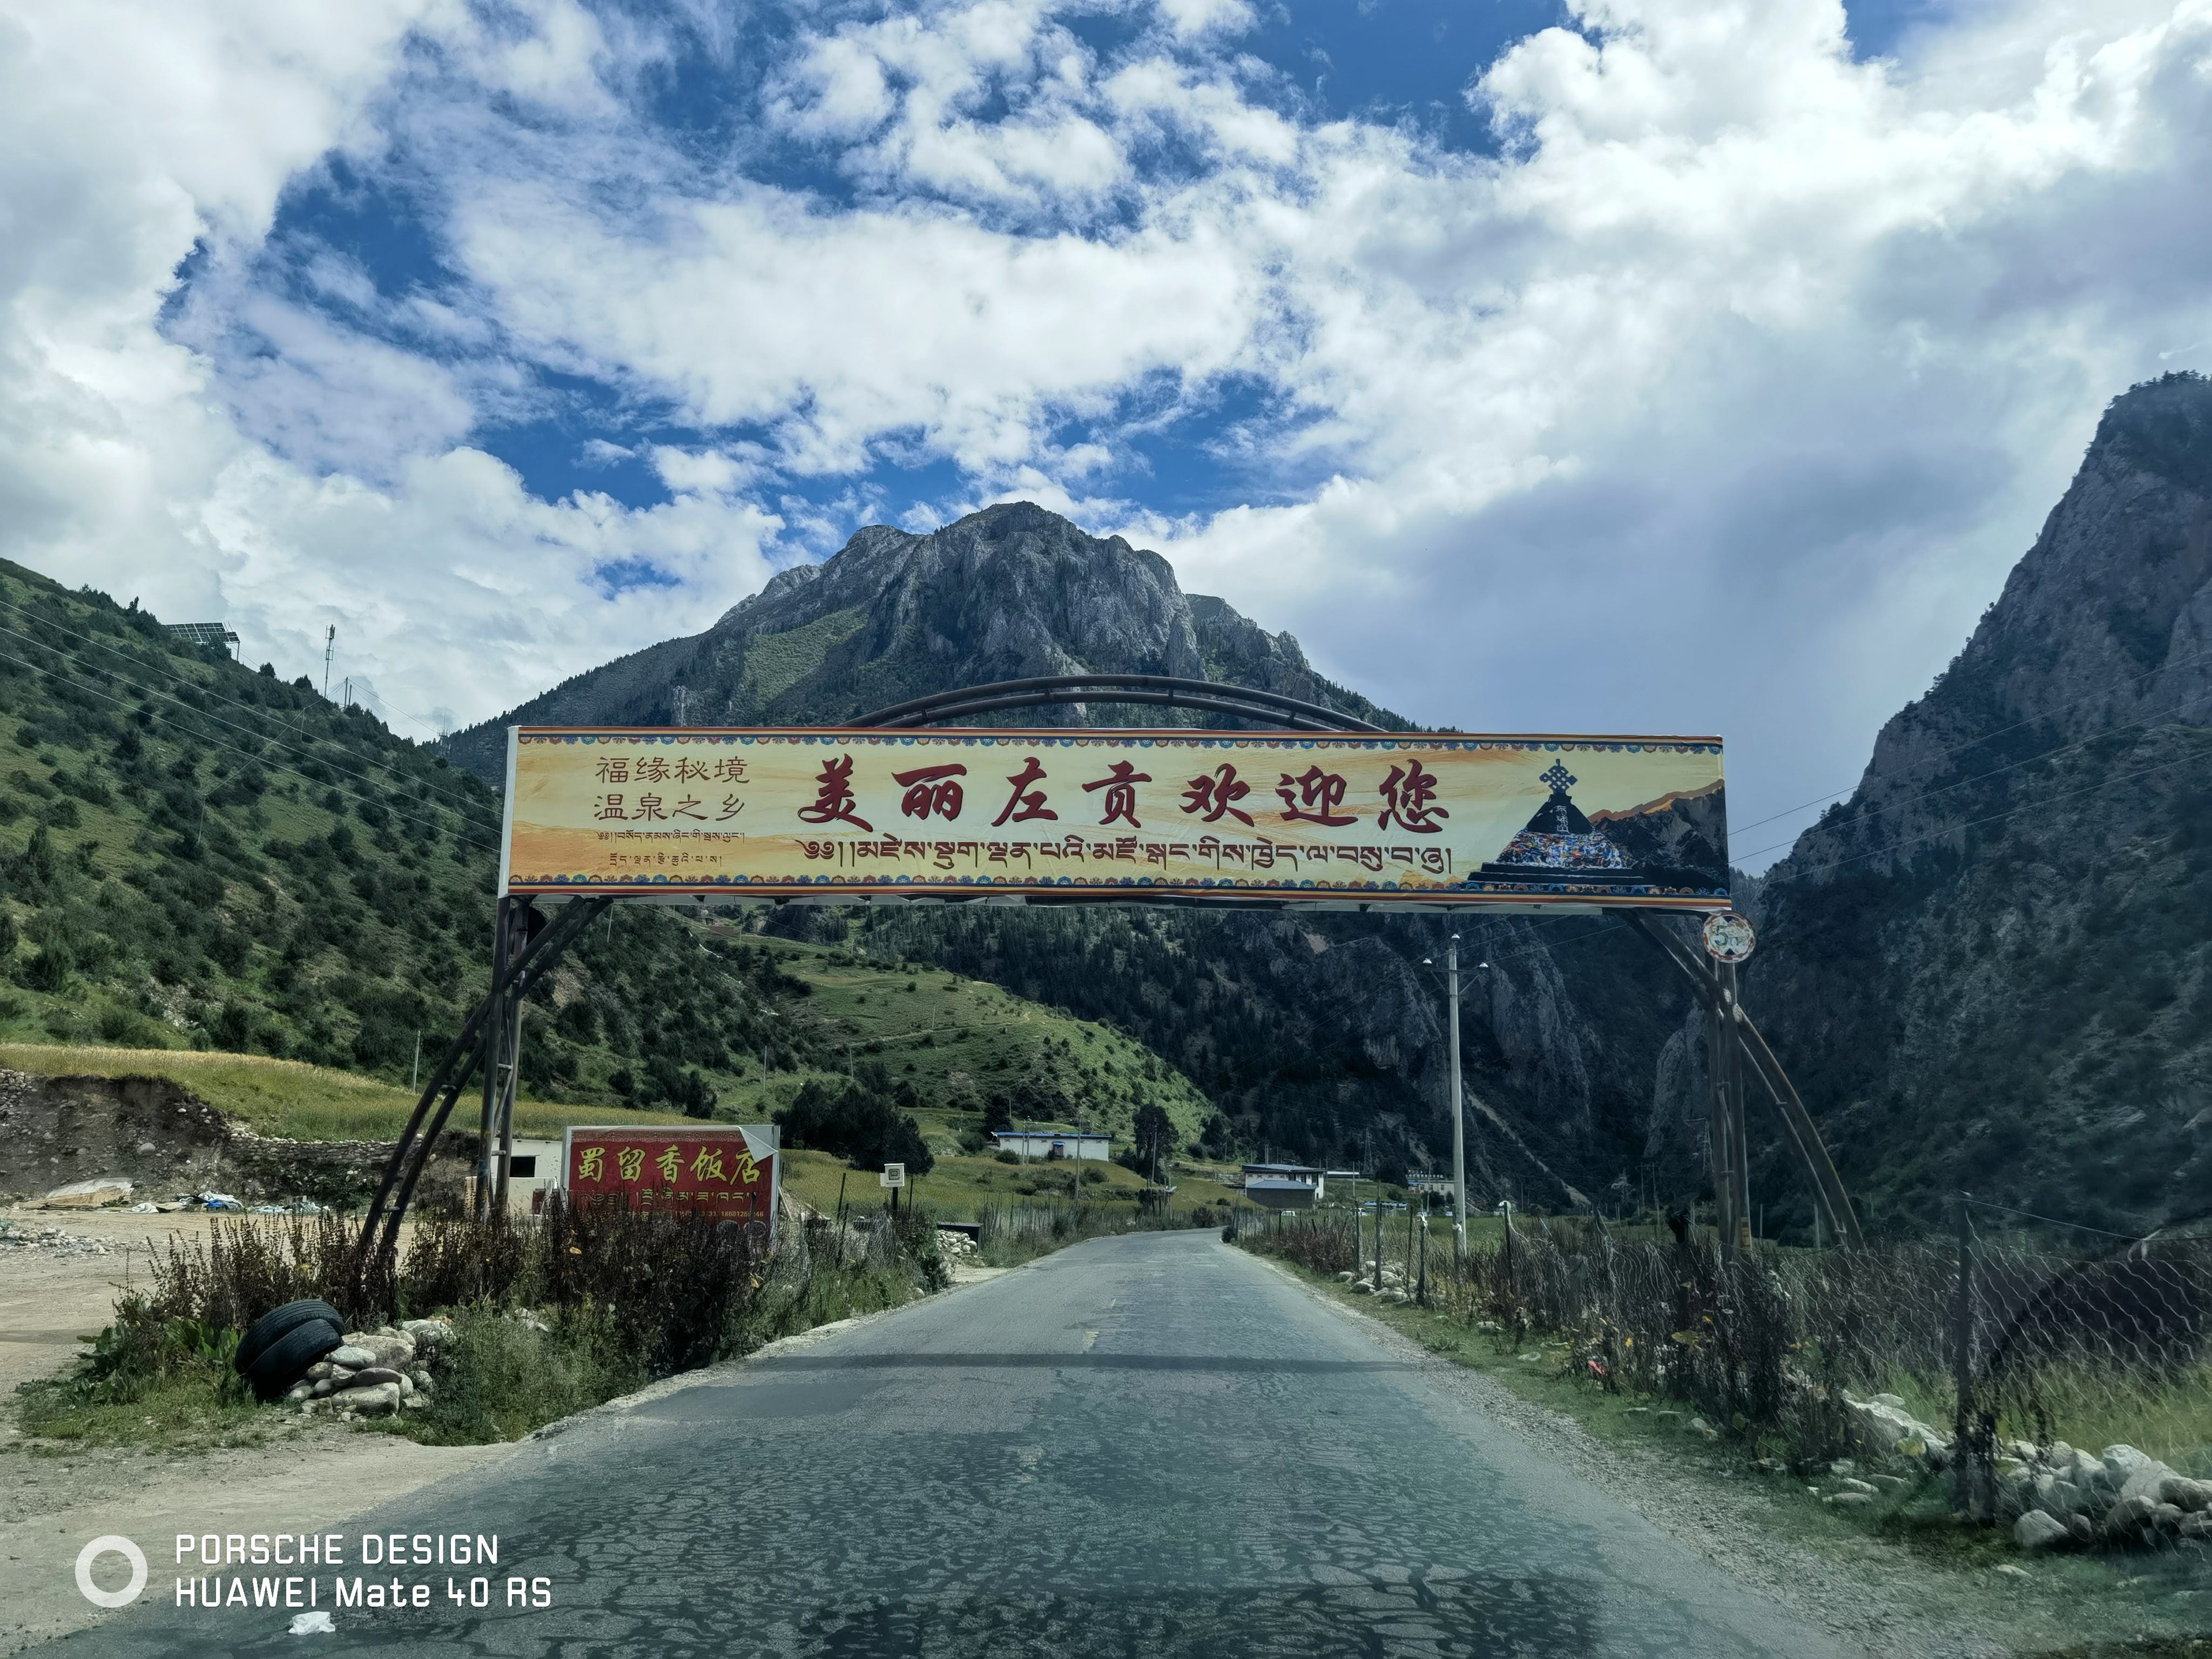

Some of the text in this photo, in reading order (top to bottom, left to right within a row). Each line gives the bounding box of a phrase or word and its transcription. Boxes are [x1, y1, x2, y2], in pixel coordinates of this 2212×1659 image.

[595, 756, 750, 784] 福缘秘境
[594, 792, 745, 821] 温泉之乡
[797, 753, 1449, 833] 美丽左贡欢迎您
[578, 1143, 760, 1185] 蜀留香饭店
